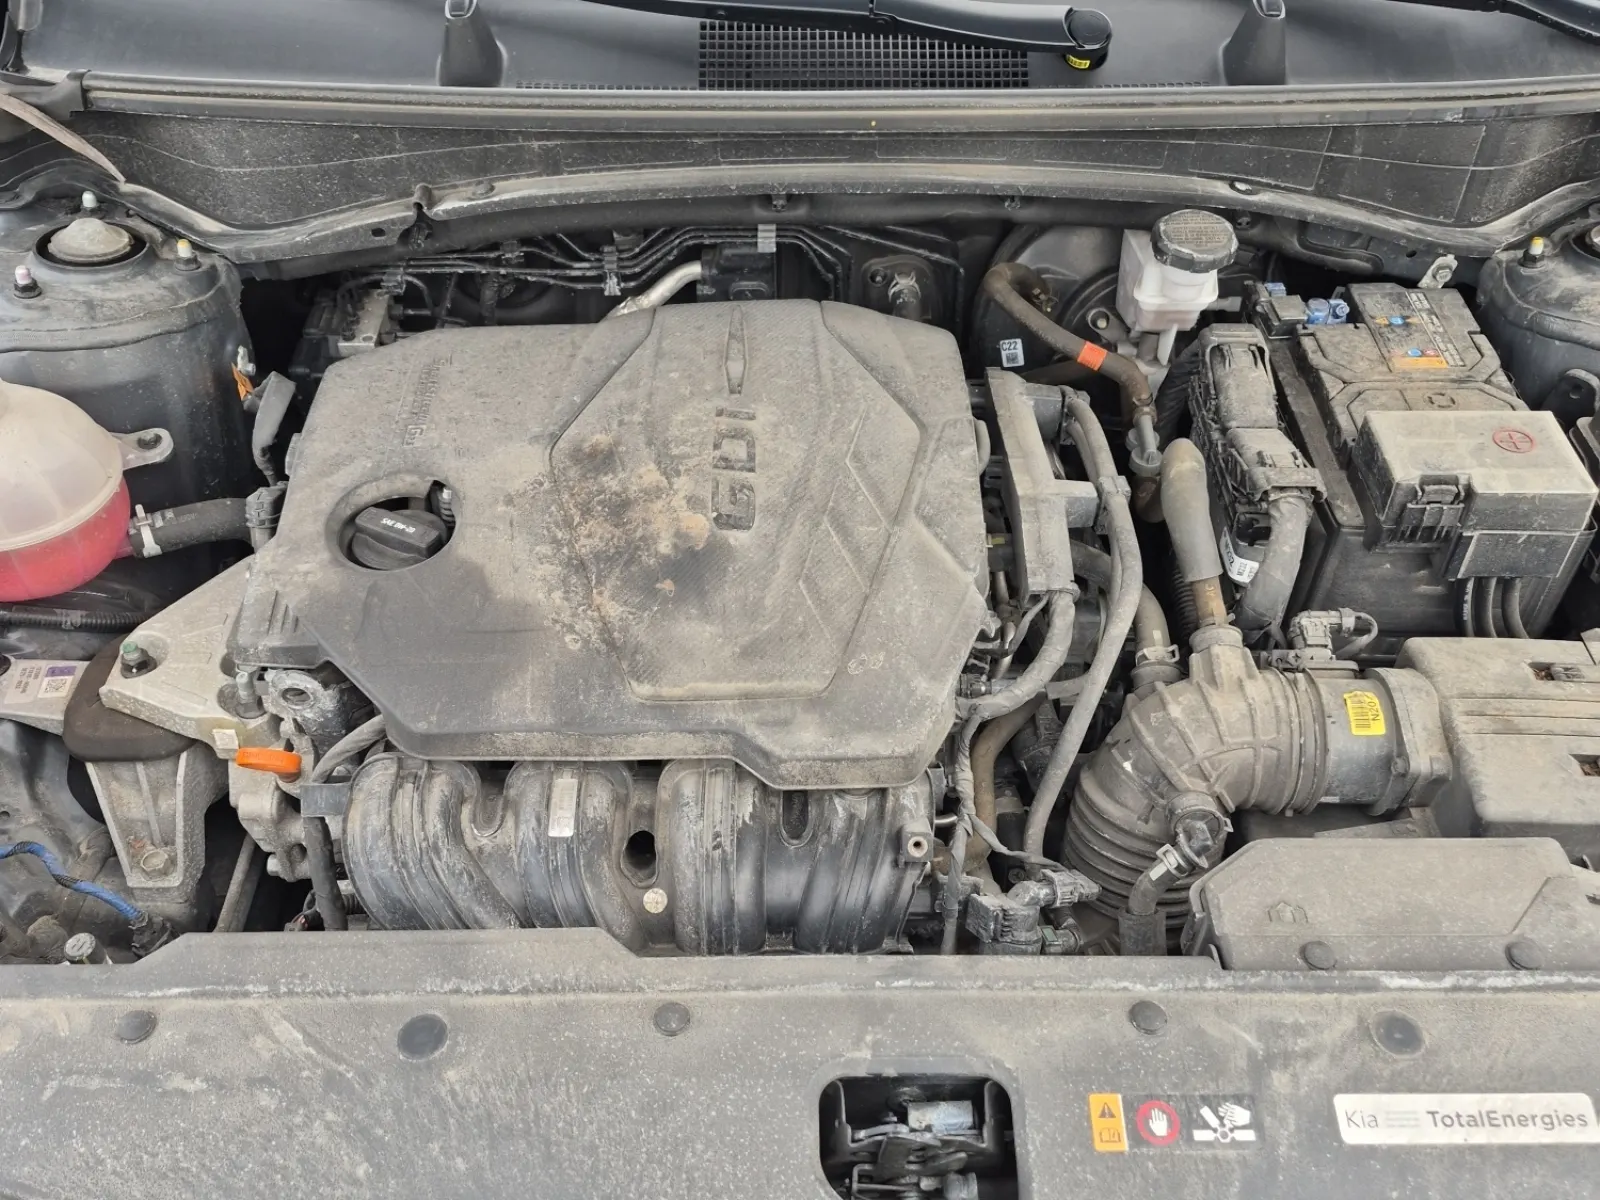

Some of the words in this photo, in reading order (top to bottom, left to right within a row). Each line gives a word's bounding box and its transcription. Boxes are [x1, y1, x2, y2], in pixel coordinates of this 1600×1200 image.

[1001, 340, 1018, 351] C22
[1344, 1109, 1379, 1129] Kia
[1426, 1109, 1588, 1131] TotalEnergies
